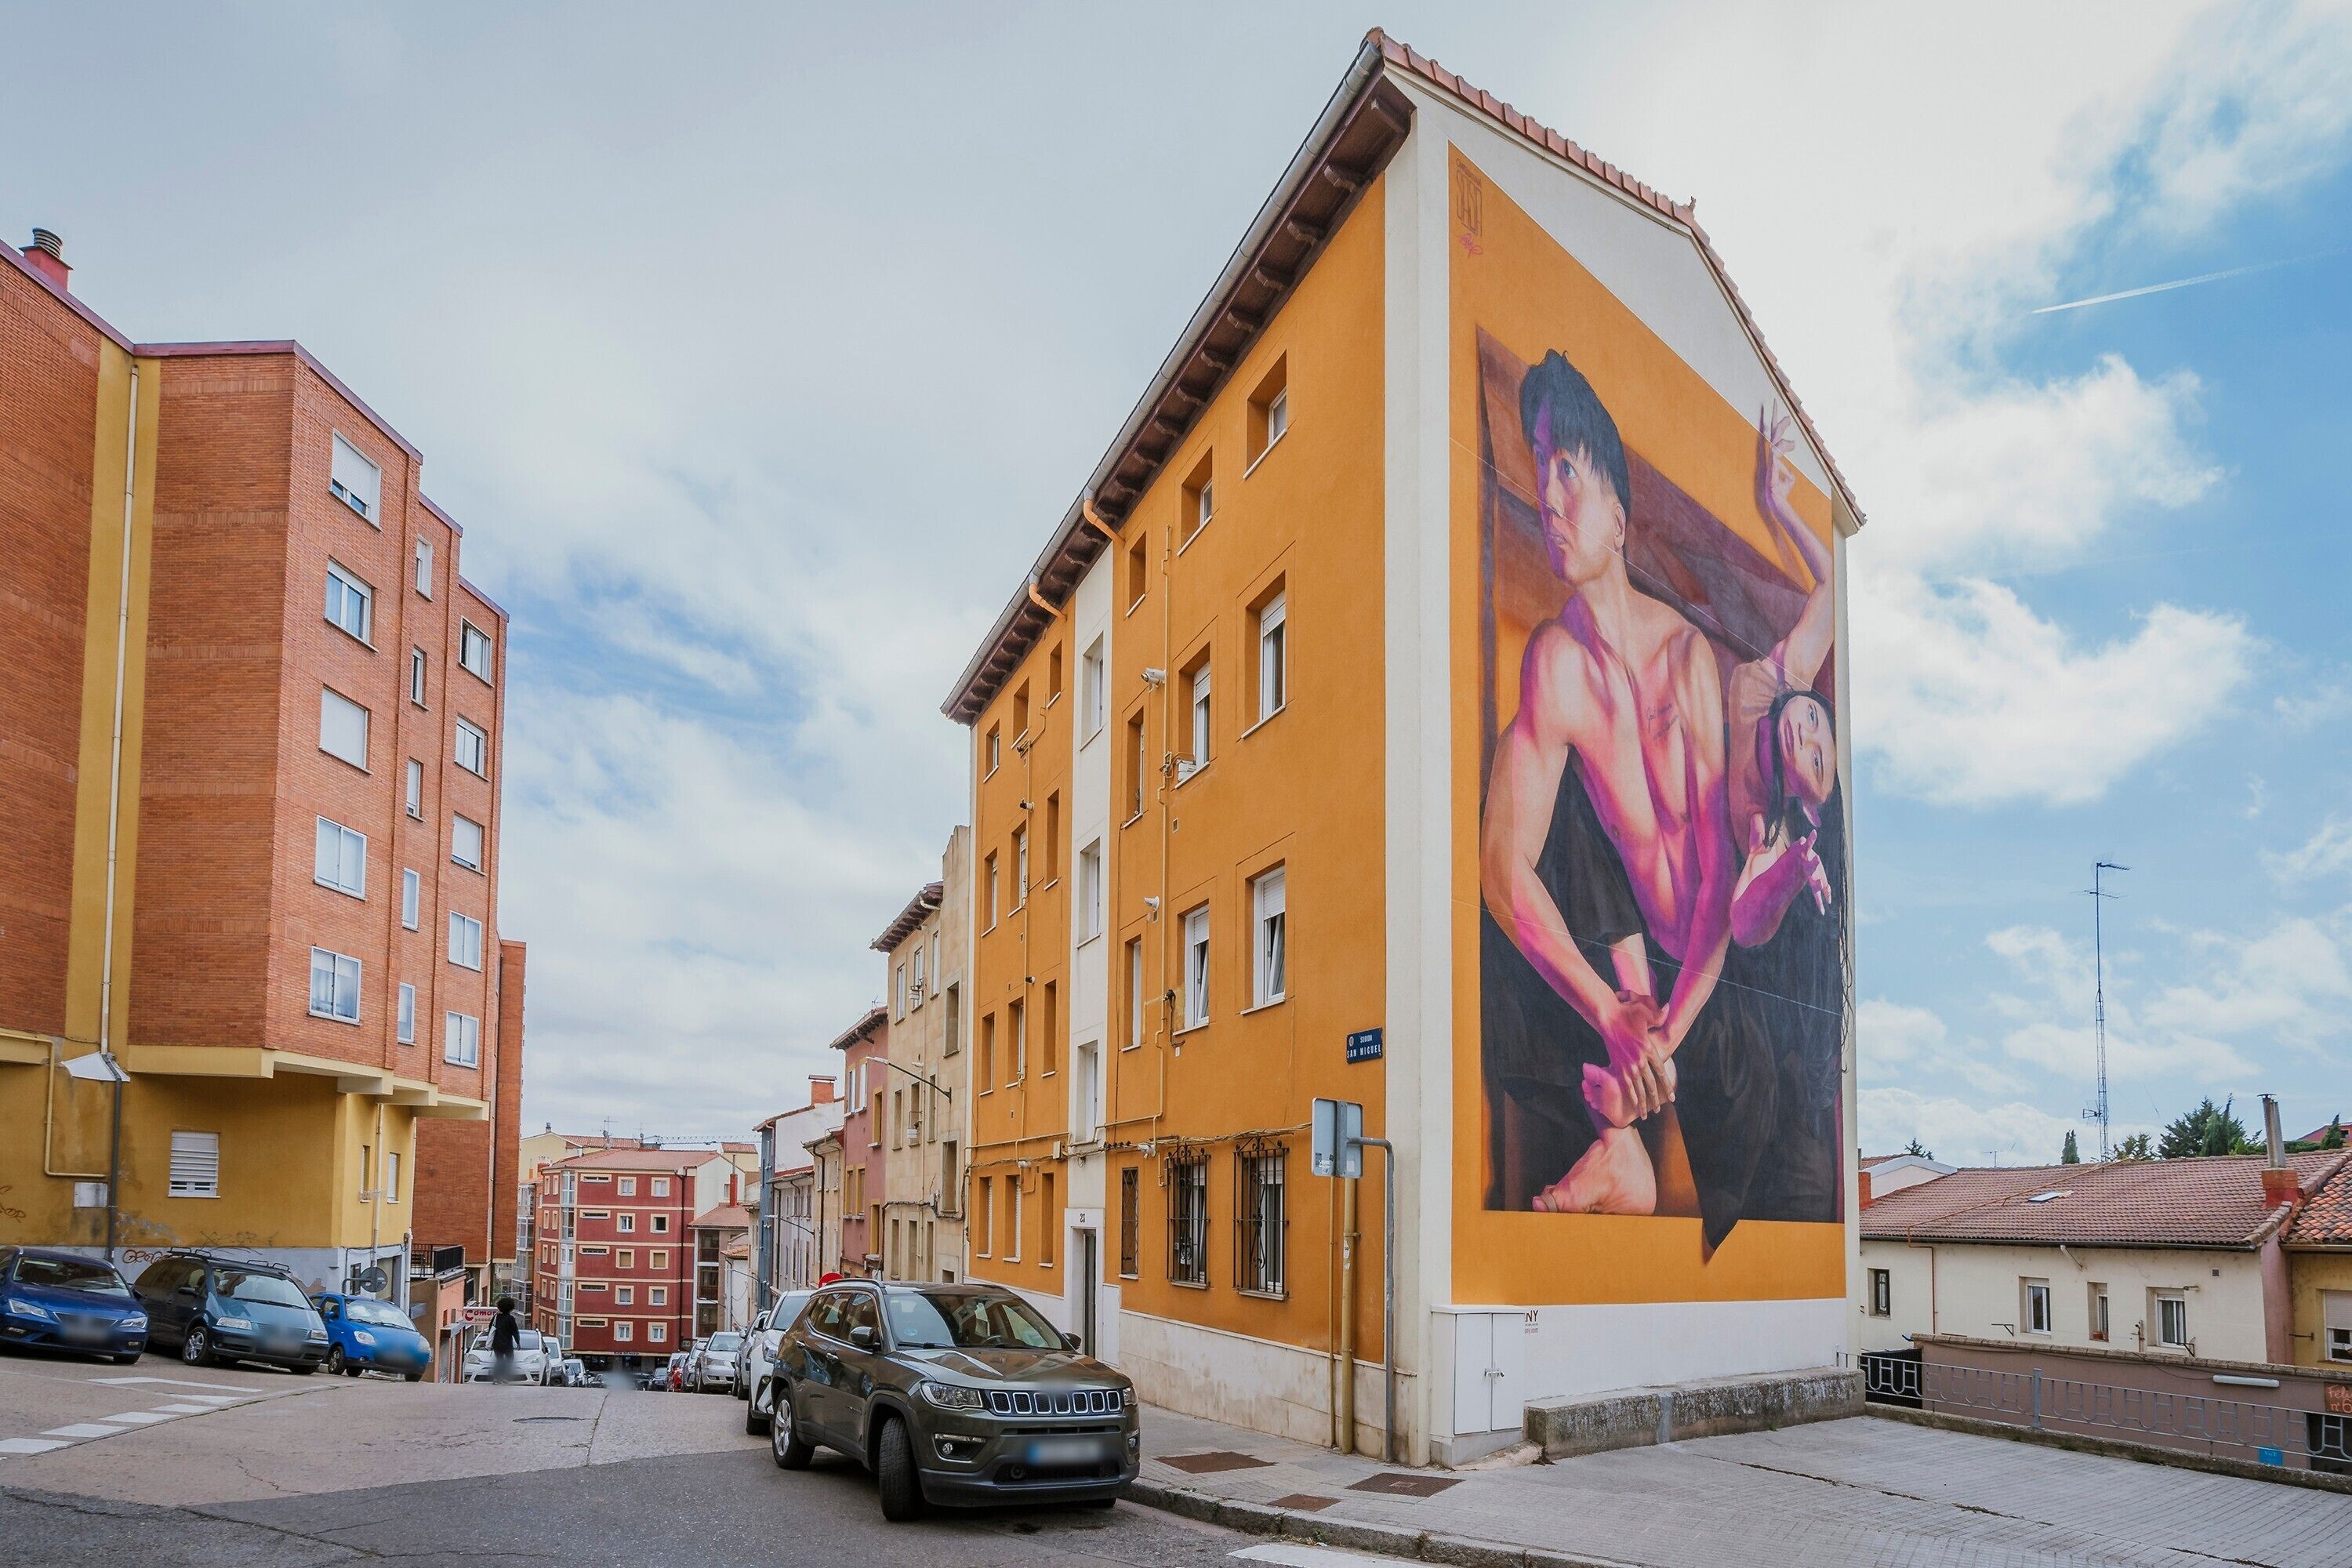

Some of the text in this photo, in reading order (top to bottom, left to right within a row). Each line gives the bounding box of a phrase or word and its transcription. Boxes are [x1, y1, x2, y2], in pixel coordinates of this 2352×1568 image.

[1360, 1034, 1373, 1044] SUBIDA
[1347, 1044, 1381, 1058] SAN MIGUEL
[465, 1308, 499, 1322] Camar
